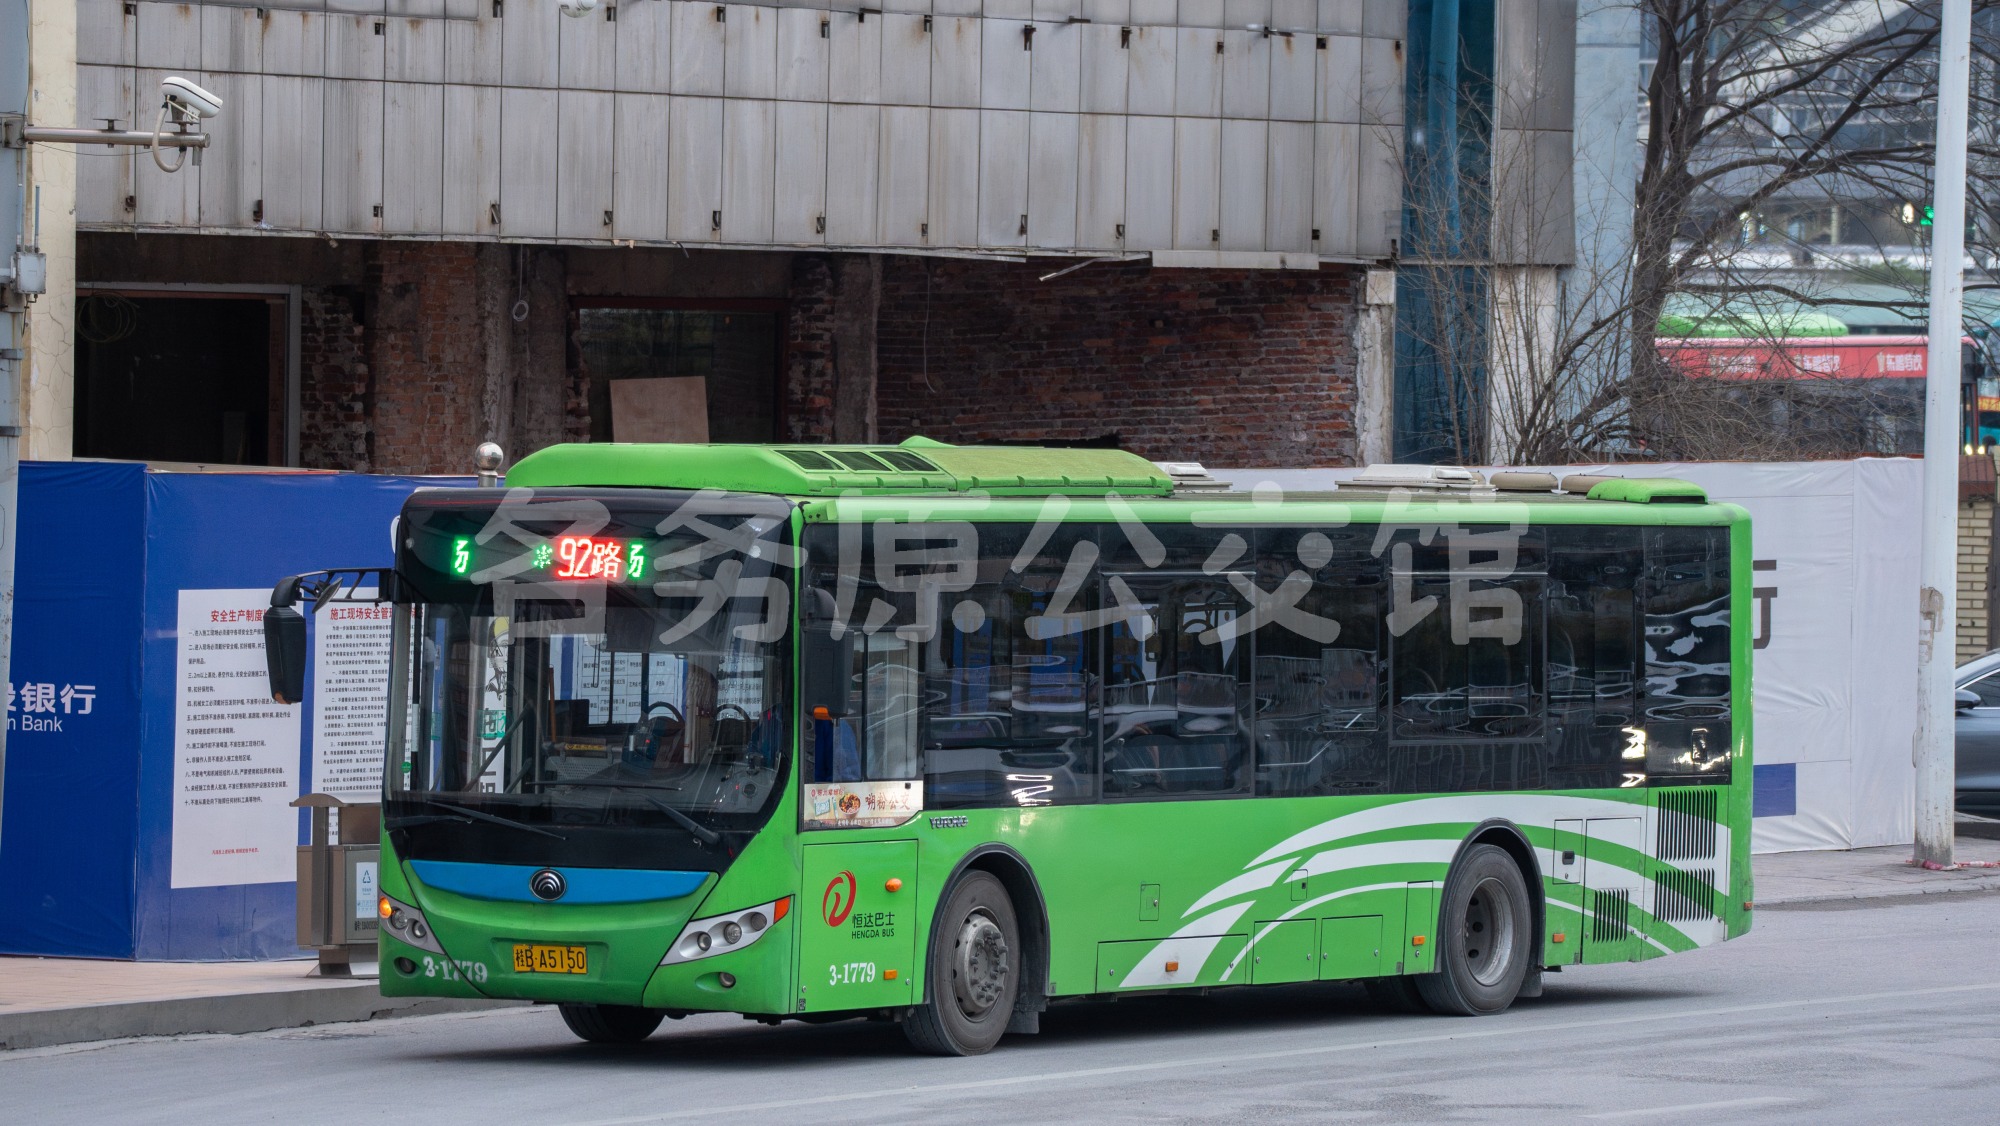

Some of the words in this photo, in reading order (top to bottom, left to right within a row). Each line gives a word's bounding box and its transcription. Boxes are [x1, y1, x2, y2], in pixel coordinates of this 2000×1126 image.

[558, 538, 622, 577] 92路
[211, 609, 267, 623] 安全生产制度
[22, 715, 63, 733] Bank
[852, 912, 895, 928] 恒达巴士
[851, 930, 880, 940] HENGDA
[882, 928, 895, 938] BUS
[829, 962, 876, 986] 3-1779
